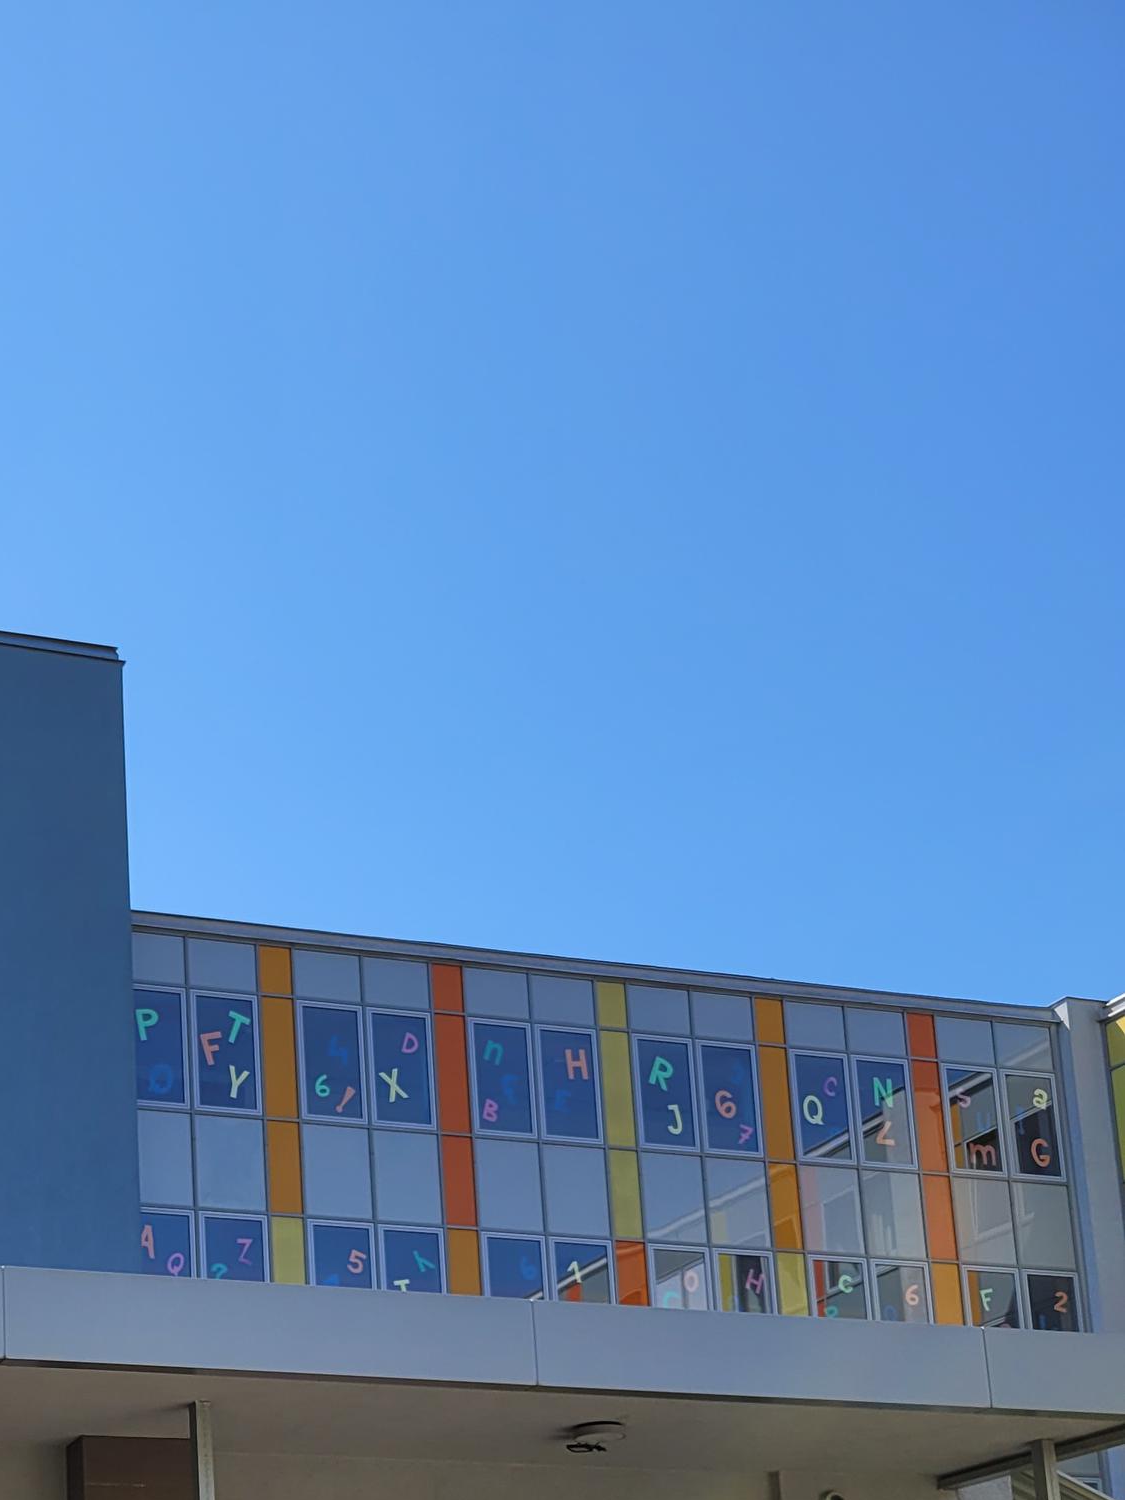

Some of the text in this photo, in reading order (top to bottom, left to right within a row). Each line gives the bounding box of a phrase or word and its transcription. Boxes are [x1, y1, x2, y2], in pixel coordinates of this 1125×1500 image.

[135, 1008, 160, 1041] P
[228, 1010, 251, 1044] T
[199, 1031, 222, 1066] F
[401, 1031, 419, 1054] D
[565, 1048, 589, 1080] H
[648, 1056, 673, 1092] R
[229, 1064, 250, 1099] Y
[315, 1074, 330, 1097] 6
[378, 1068, 410, 1103] X
[873, 1077, 893, 1108] N
[482, 1098, 499, 1122] B
[715, 1090, 737, 1119] 6
[803, 1095, 825, 1126] Q
[667, 1104, 683, 1135] J
[737, 1123, 754, 1145] 7
[1031, 1138, 1051, 1168] G
[167, 1252, 184, 1277] Q
[347, 1248, 367, 1274] 5
[746, 1268, 766, 1294] H
[906, 1284, 919, 1306] 6
[980, 1288, 993, 1312] F
[1054, 1291, 1068, 1314] 2
